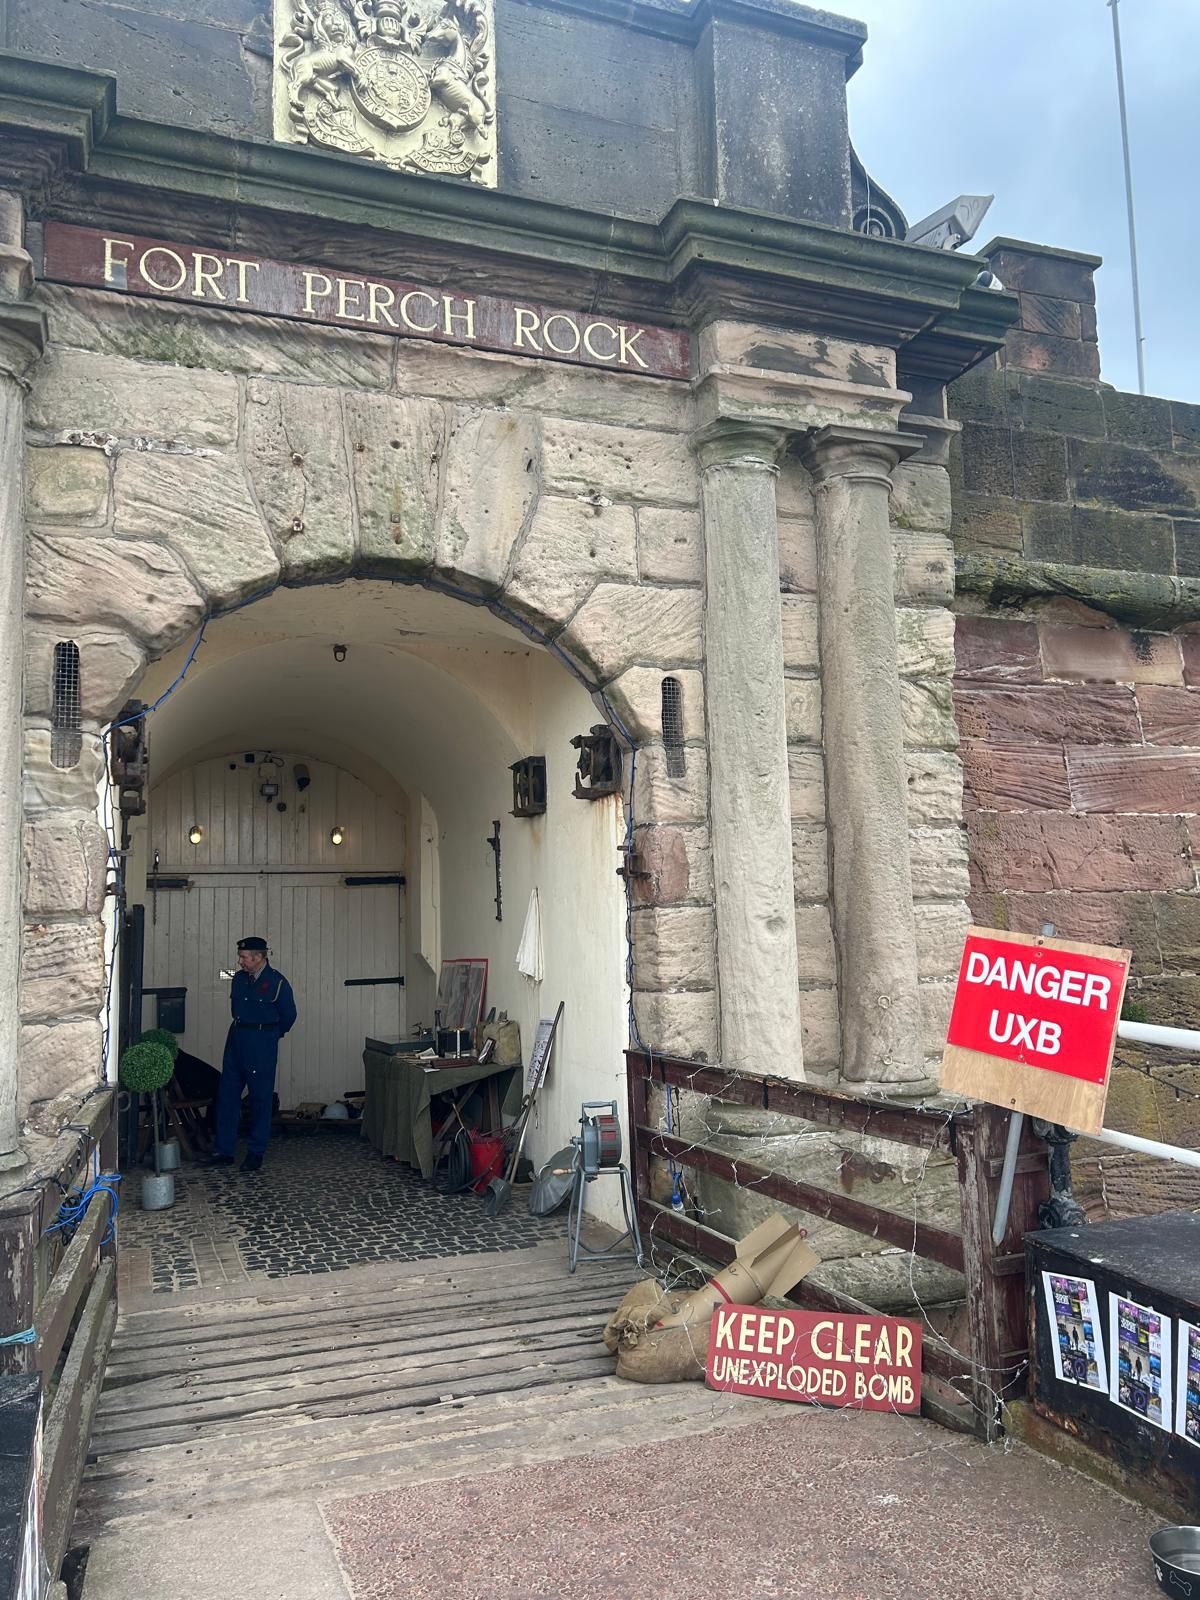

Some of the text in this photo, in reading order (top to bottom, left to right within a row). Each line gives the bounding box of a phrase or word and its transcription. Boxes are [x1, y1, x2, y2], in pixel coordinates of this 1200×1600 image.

[102, 238, 649, 368] FORT PERCH ROCK
[965, 952, 1111, 1010] DANGER
[989, 1010, 1061, 1055] UXB
[715, 1311, 913, 1368] KEEP CLEAR
[713, 1356, 914, 1404] UNEXPLODED BOMB
